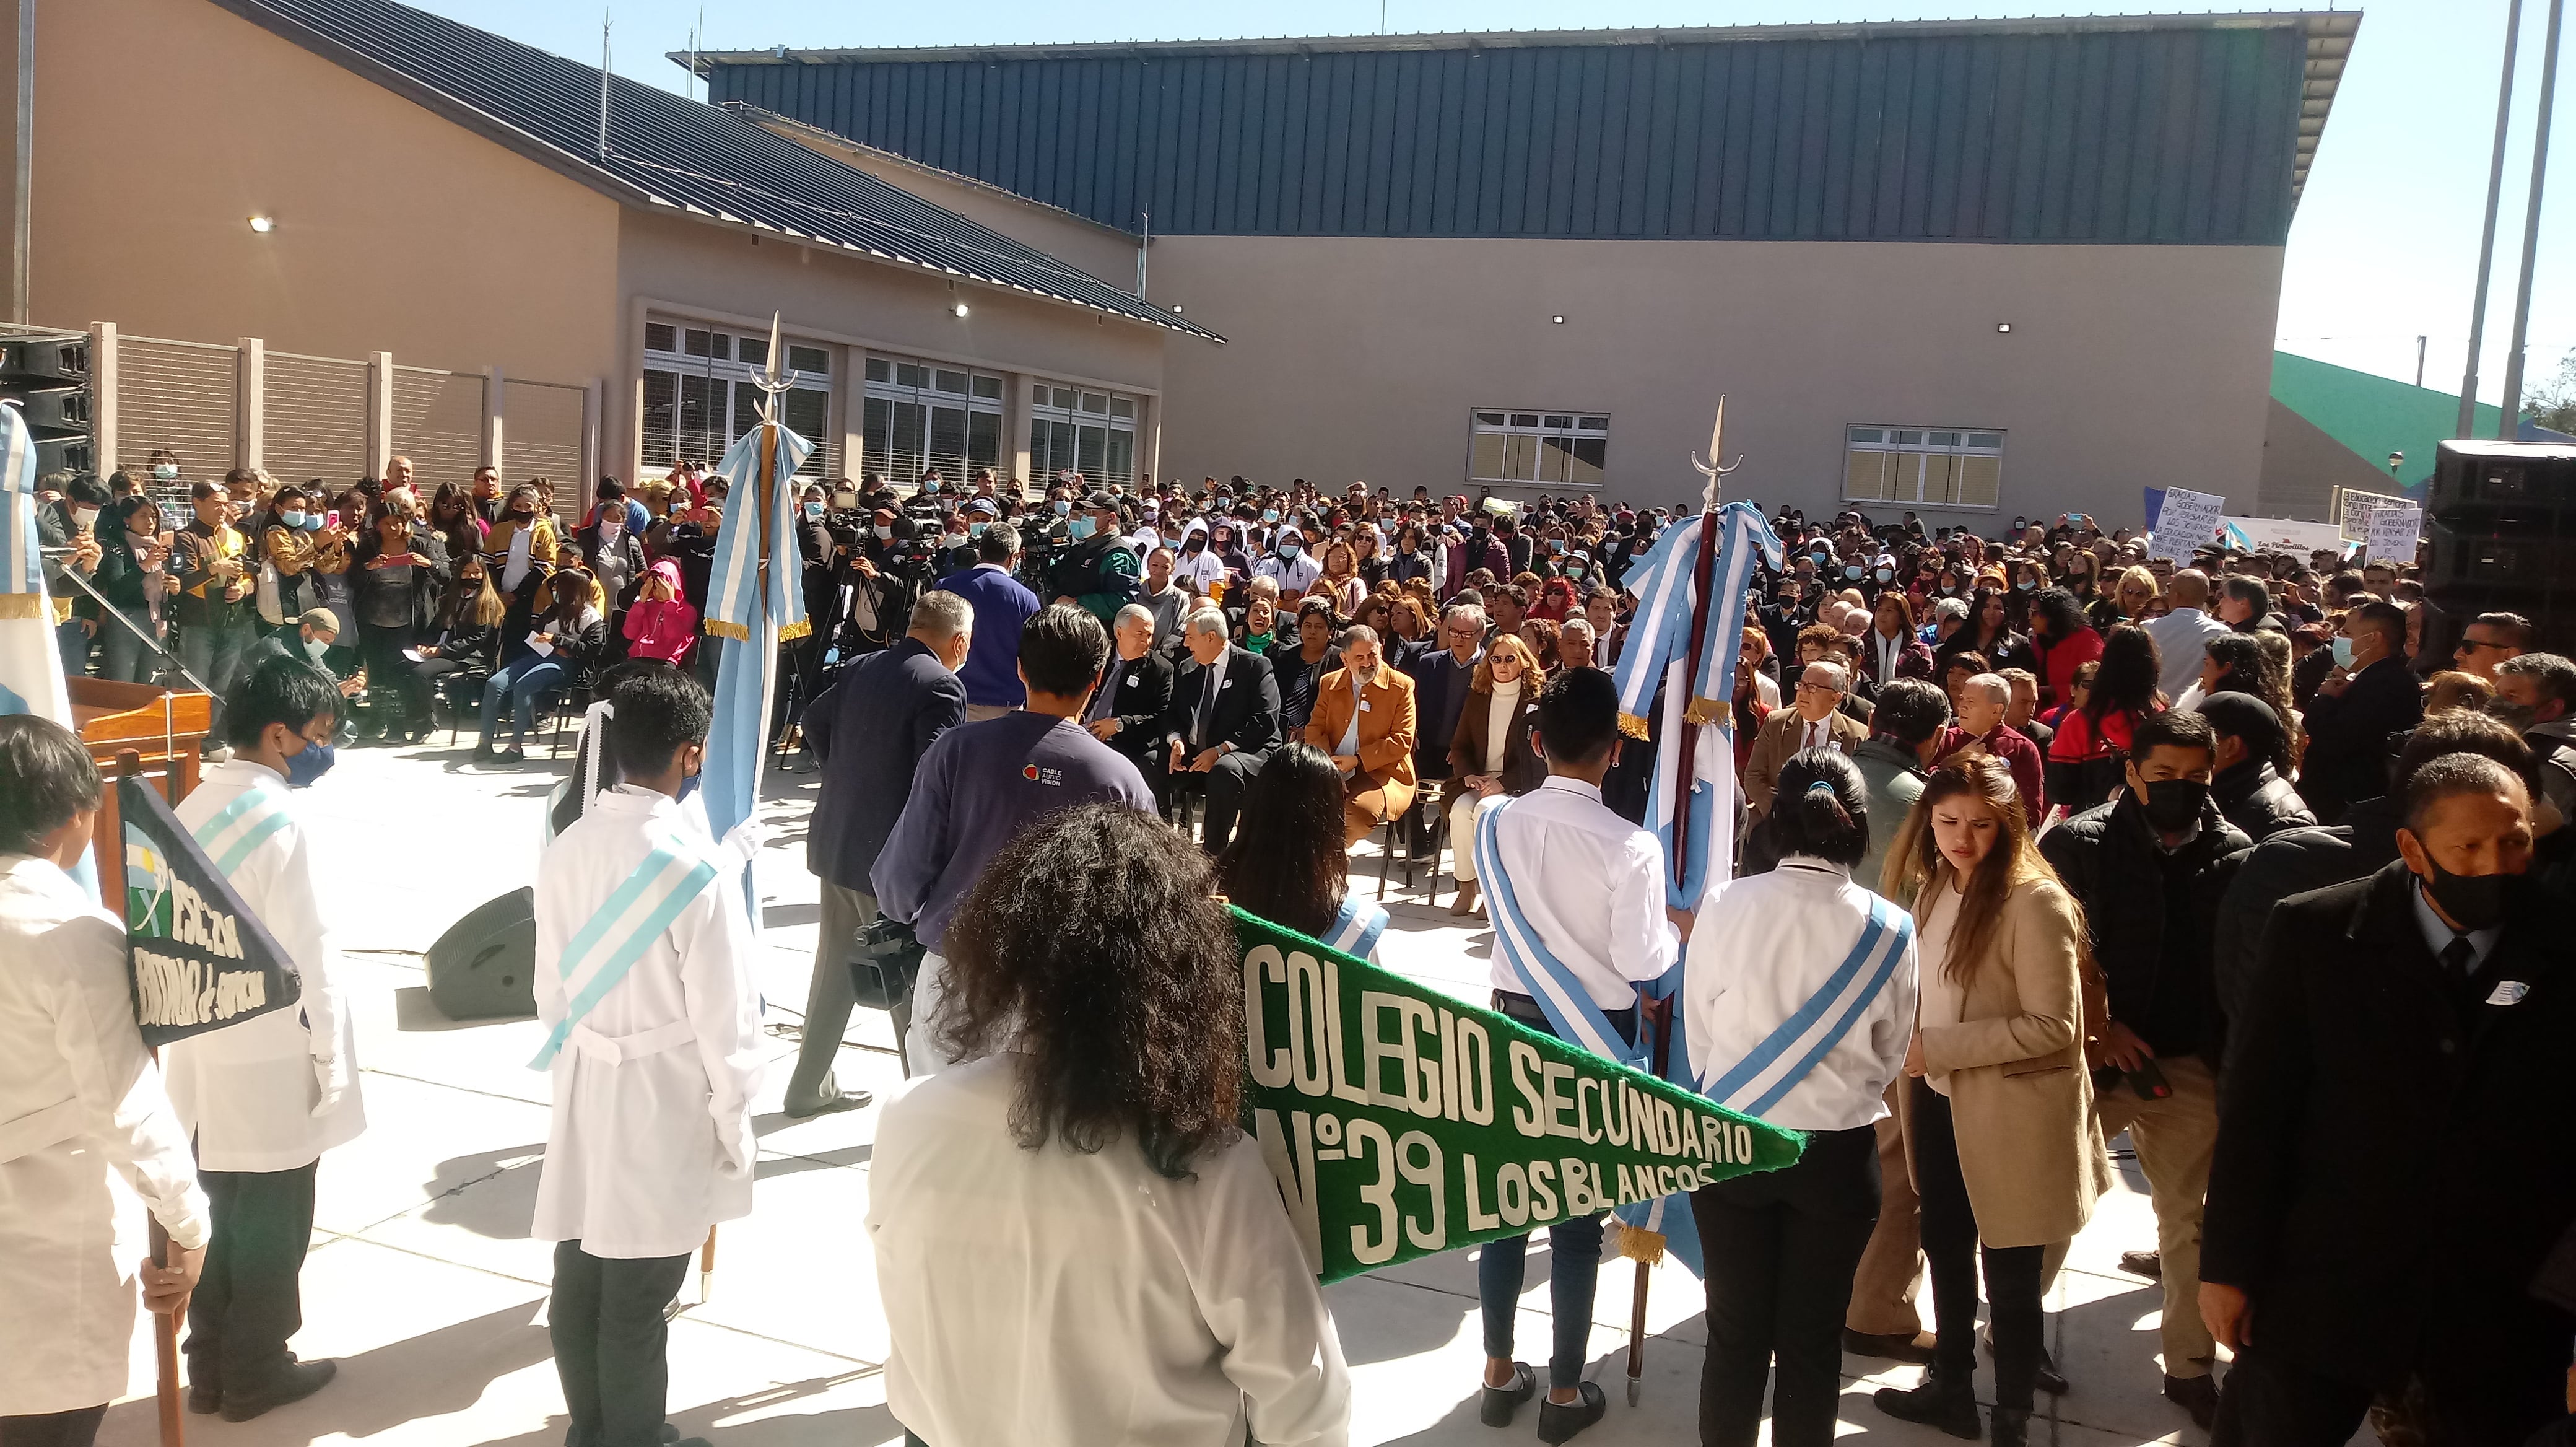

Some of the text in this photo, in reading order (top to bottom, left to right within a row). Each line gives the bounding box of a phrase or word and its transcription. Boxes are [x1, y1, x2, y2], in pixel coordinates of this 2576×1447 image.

[1042, 767, 1063, 776] CABLE
[1042, 779, 1060, 787] VISION
[1243, 944, 1752, 1165] COLEGIO SECUNDARIO
[1462, 1152, 1559, 1232] LOS
[1562, 1157, 1718, 1217] BLANCOS
